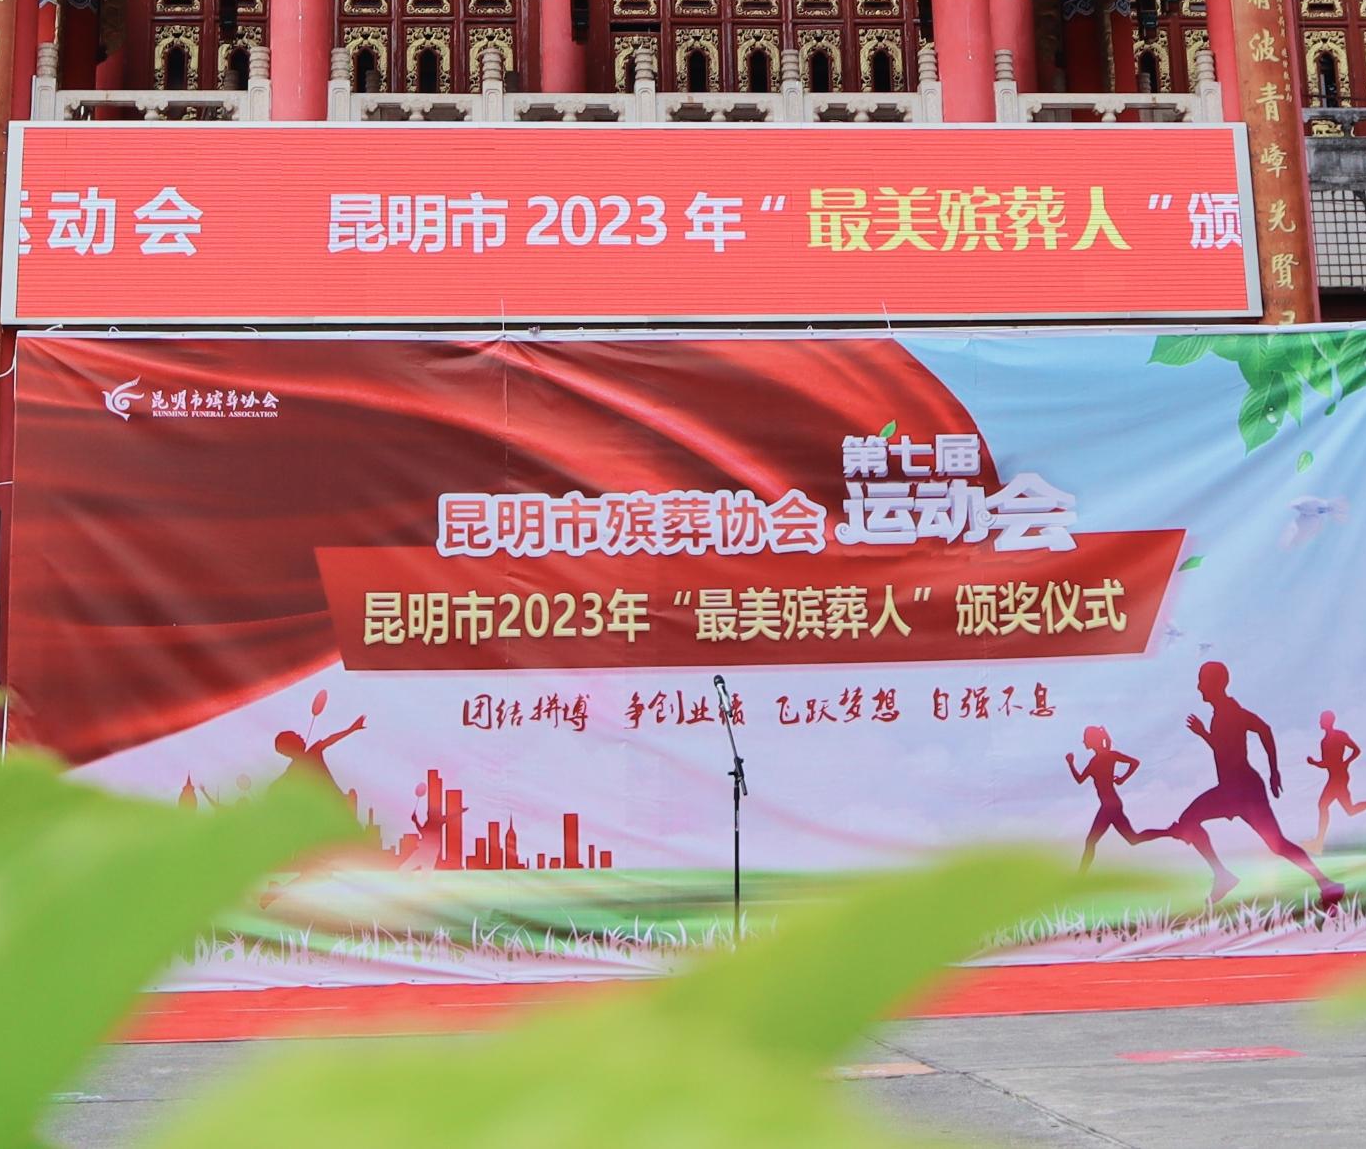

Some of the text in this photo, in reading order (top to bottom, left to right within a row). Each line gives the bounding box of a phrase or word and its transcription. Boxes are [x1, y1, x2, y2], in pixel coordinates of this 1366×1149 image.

[151, 389, 280, 410] 昆明市殡葬协会
[152, 410, 278, 418] KUNMING FUNERAL ASSOCIATION
[842, 434, 981, 478] 第七届
[439, 492, 825, 554] 昆明市殡葬协会
[835, 472, 1078, 552] 运动会
[776, 687, 900, 725] 飞跃梦想
[933, 682, 1057, 721] 自强不息
